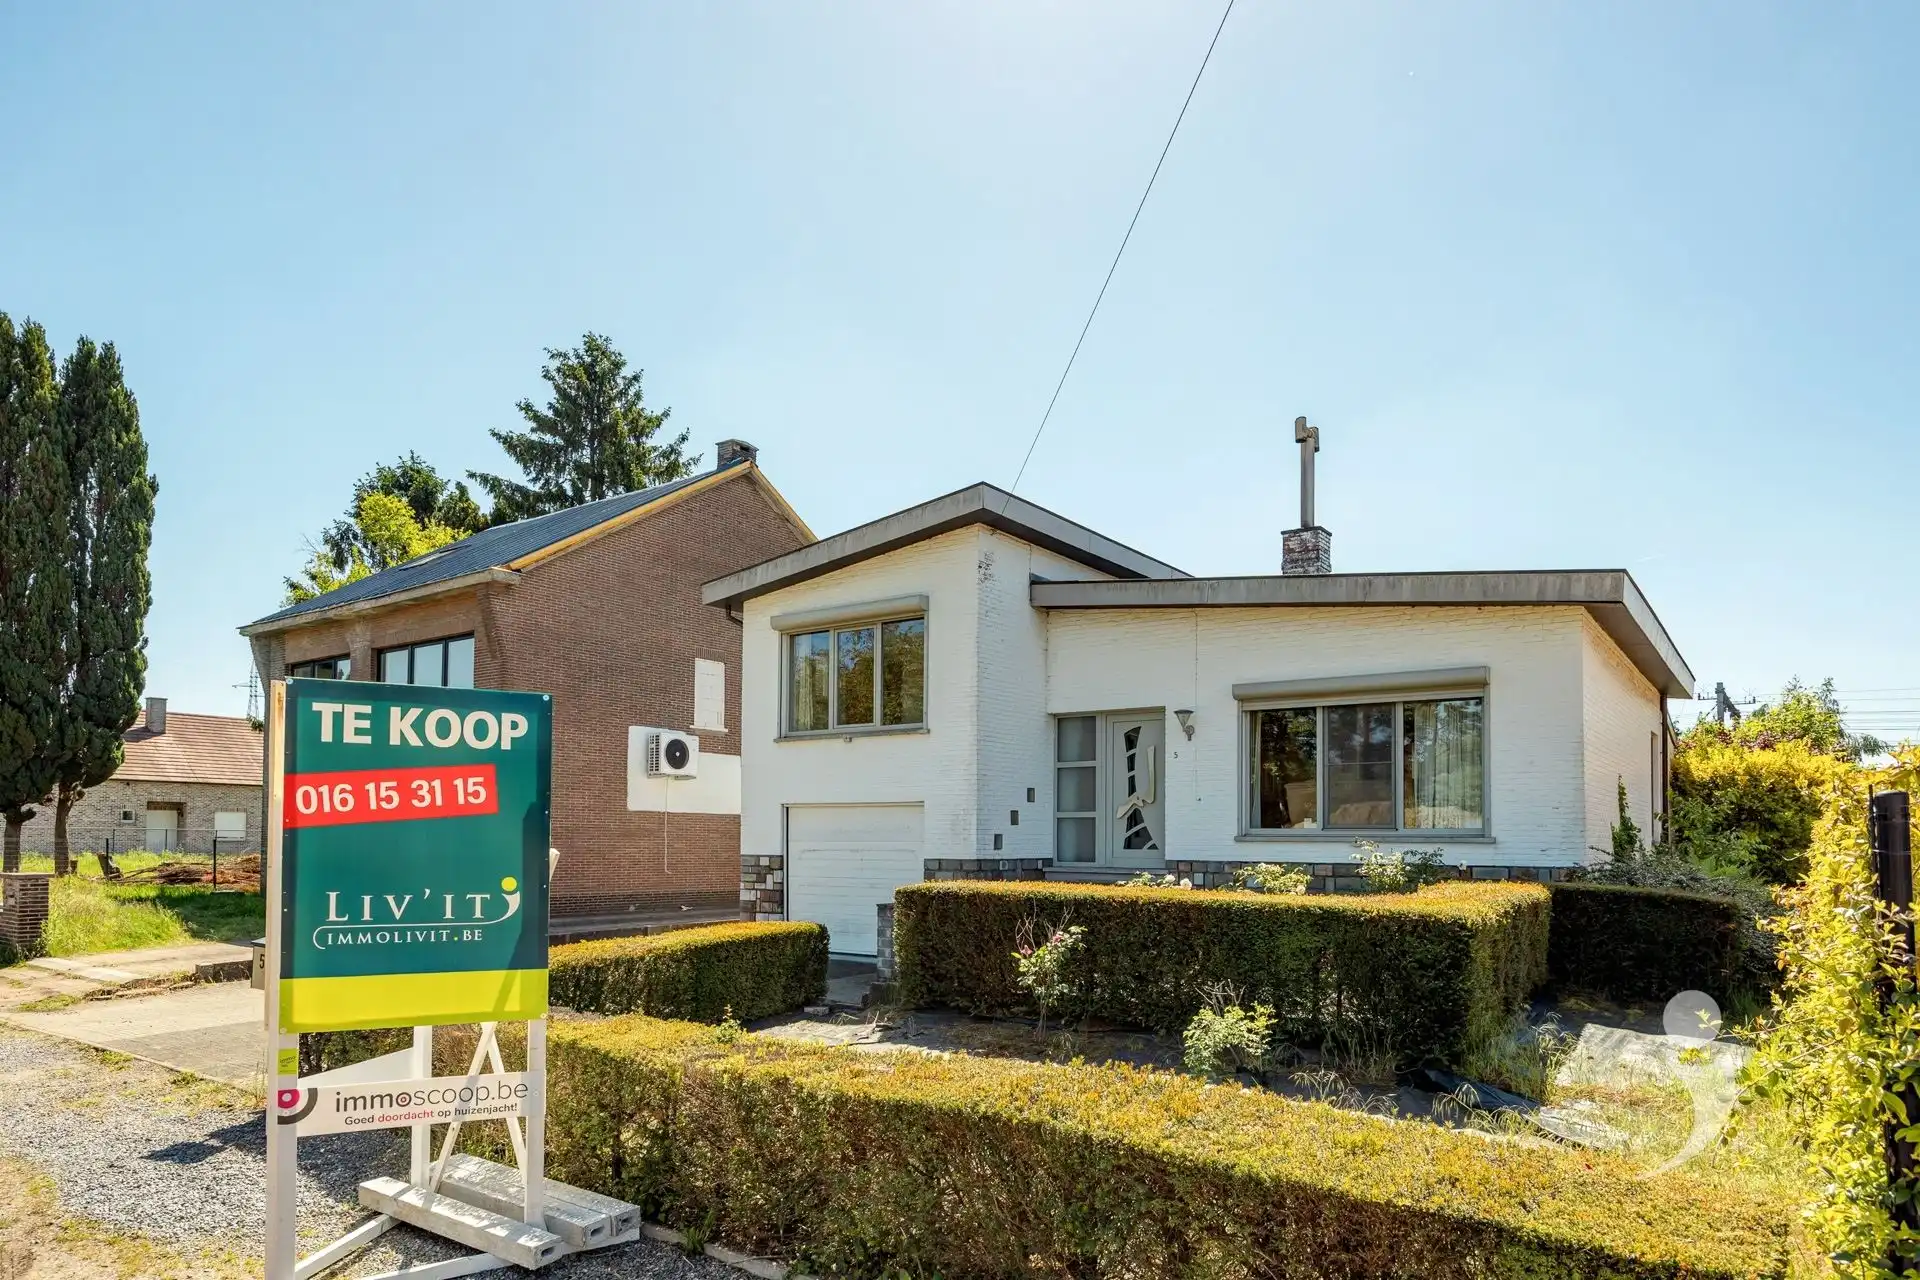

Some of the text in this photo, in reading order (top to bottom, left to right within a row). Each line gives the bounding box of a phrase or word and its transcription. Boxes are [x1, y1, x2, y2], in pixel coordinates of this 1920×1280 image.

[312, 702, 529, 750] TE KOOP
[295, 776, 487, 815] 016 15 31 15
[327, 929, 483, 945] IMMOLIVIT.BE
[335, 1080, 528, 1113] immoscoop.be
[344, 1103, 518, 1126] Goed doordacht op huizenjacht!
